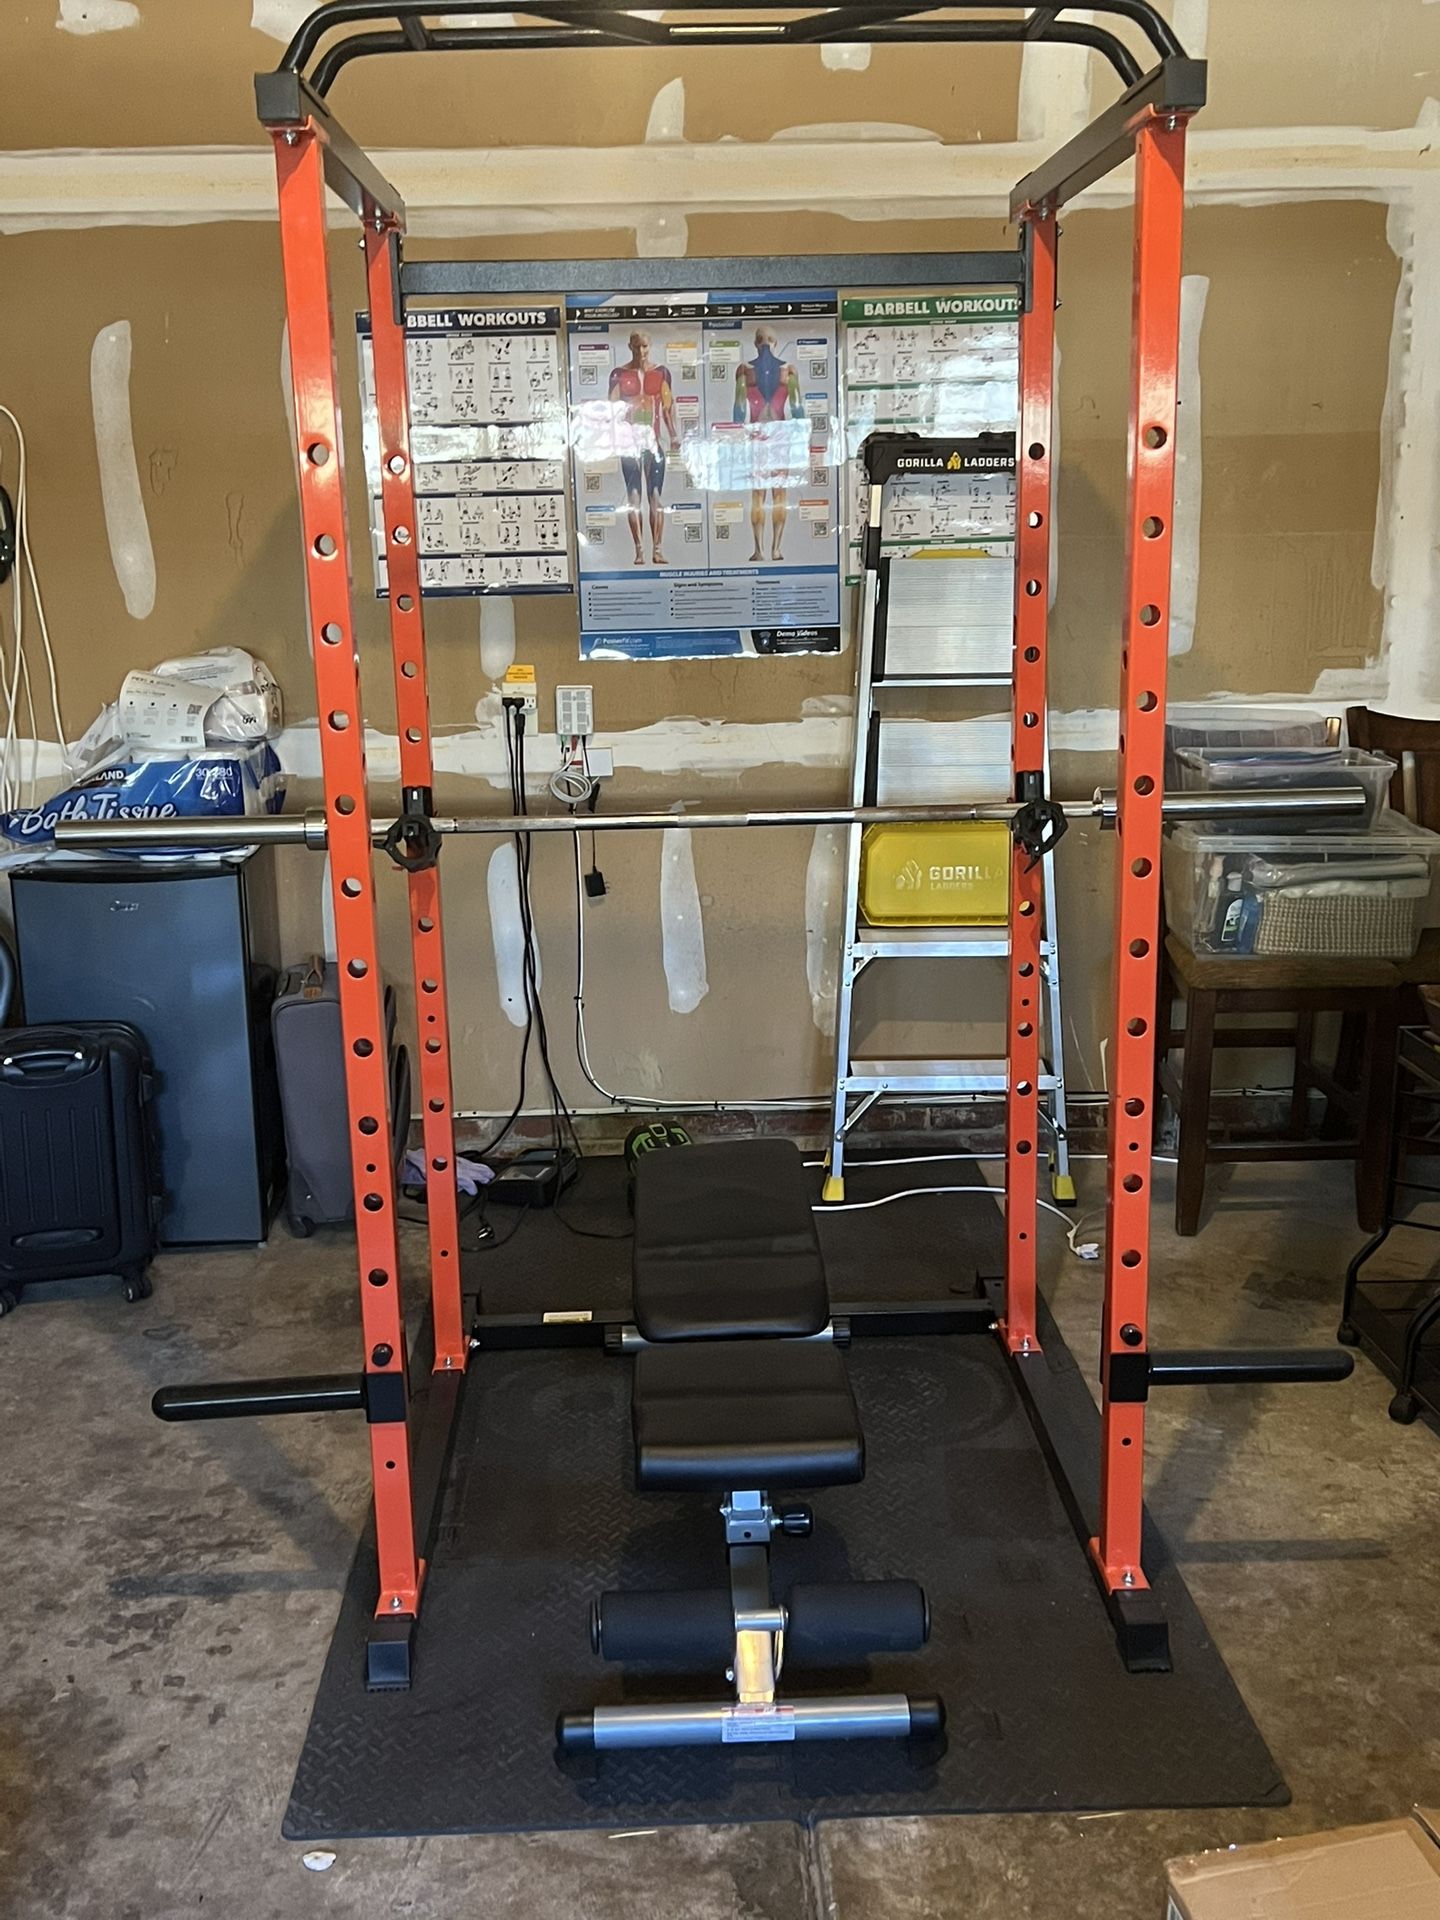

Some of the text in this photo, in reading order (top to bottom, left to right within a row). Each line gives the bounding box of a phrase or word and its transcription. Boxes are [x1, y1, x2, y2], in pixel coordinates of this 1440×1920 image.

[863, 301, 930, 316] BARBELL
[406, 312, 547, 328] BBELL WORKOUTS
[898, 457, 1014, 468] GORILLA LADDERS
[776, 629, 818, 638] Demo Videos
[93, 770, 124, 781] LAND
[20, 793, 178, 835] Bath Tissue
